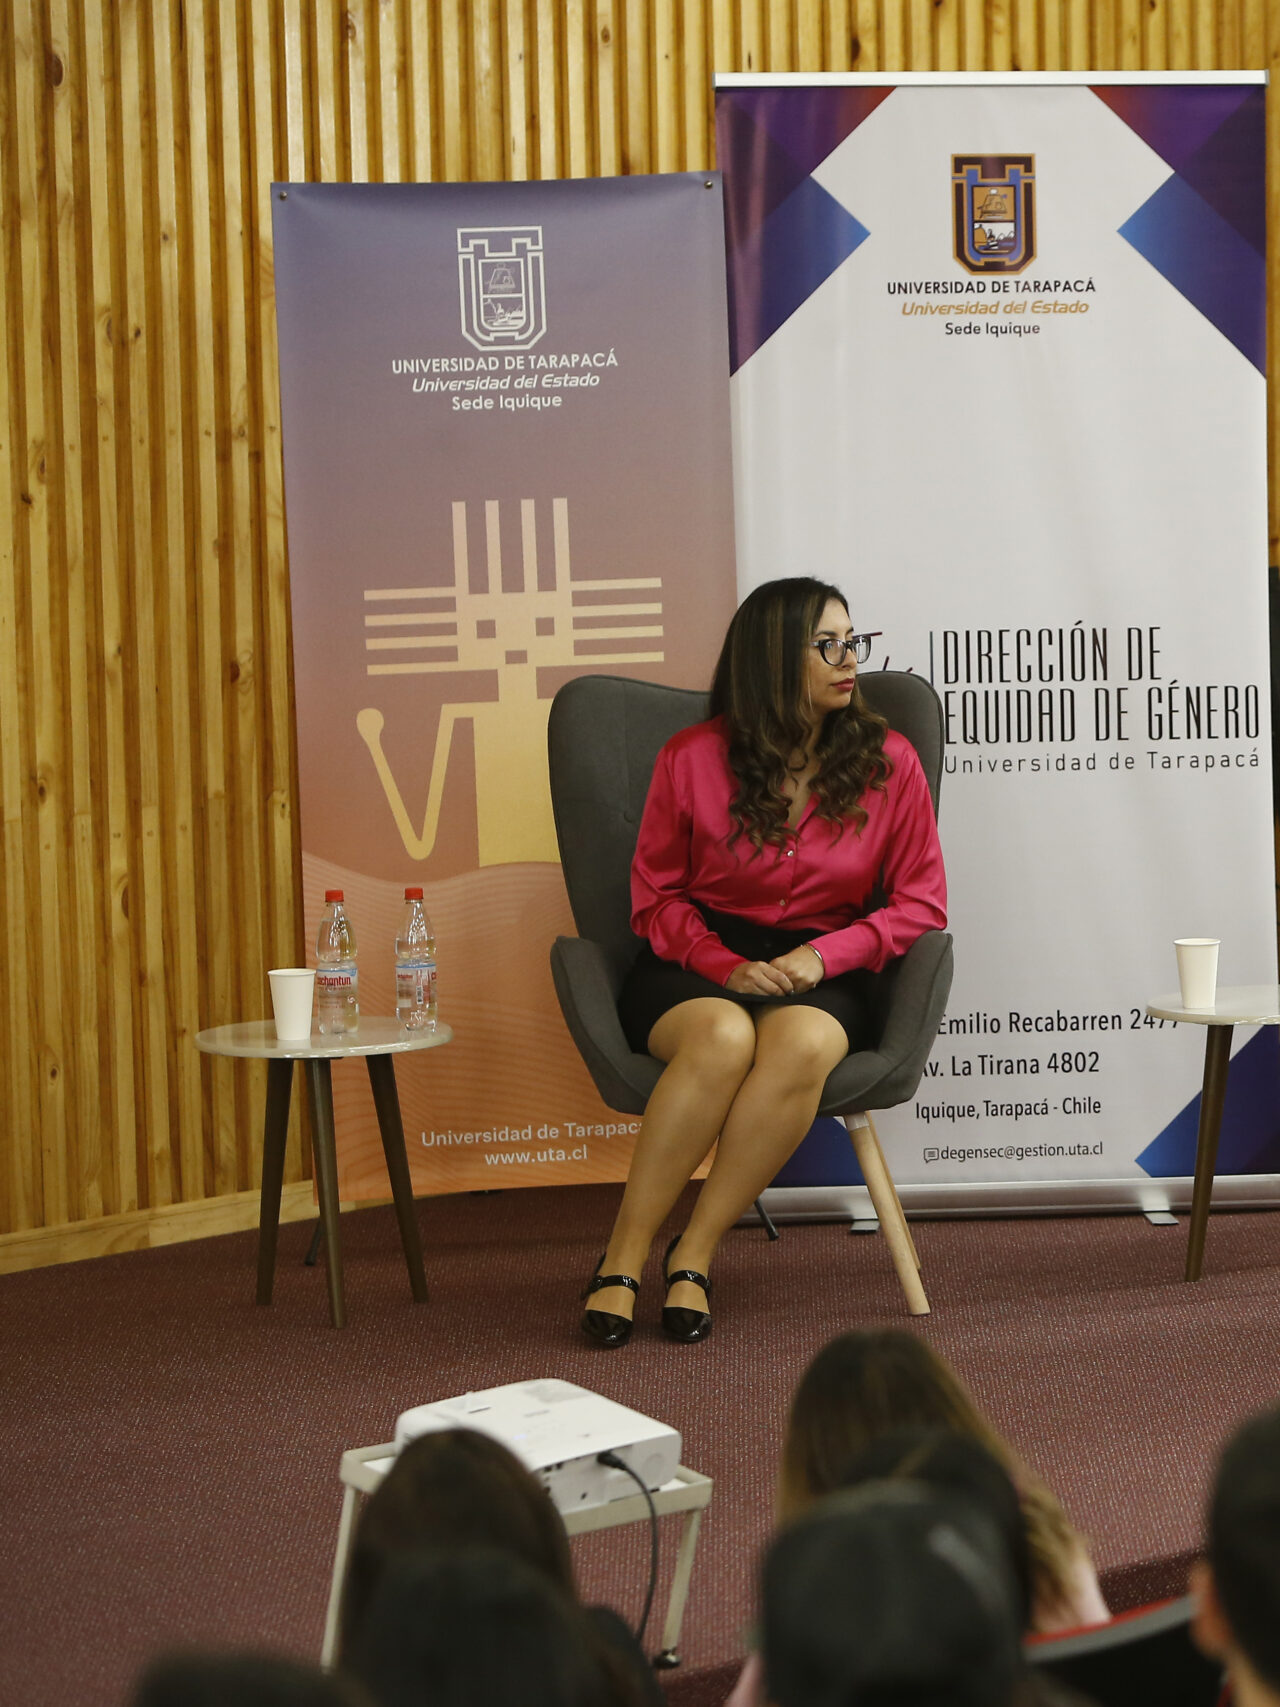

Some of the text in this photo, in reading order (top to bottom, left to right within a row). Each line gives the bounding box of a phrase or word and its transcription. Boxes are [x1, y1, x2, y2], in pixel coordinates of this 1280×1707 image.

[886, 276, 1097, 295] UNIVERSIDAD DE TARAPACÁ
[901, 300, 1090, 316] Universidad del Estado
[945, 322, 1041, 338] Sede Iquique
[391, 348, 618, 374] UNIVERSIDAD DE TARAPACÁ
[411, 373, 600, 393] Universidad del Estado
[452, 394, 563, 411] Sede Iquique
[943, 620, 1163, 684] DIRECCIÓN DE
[944, 679, 1260, 745] EQUIDAD DE GÉNERO
[944, 747, 1260, 773] Universidad de Tarapacá
[1008, 1010, 1122, 1034] Recabarren
[951, 1055, 972, 1077] La
[977, 1053, 1040, 1076] Tirana
[1046, 1051, 1100, 1074] 4802
[915, 1101, 980, 1124] Iquique,
[983, 1098, 1049, 1121] Tarapacá
[1062, 1097, 1101, 1115] Chile
[421, 1125, 532, 1147] Universidad
[537, 1123, 559, 1140] de
[484, 1145, 588, 1166] www.uta.cl
[940, 1142, 1104, 1163] degensec@gestion.uta.cl
